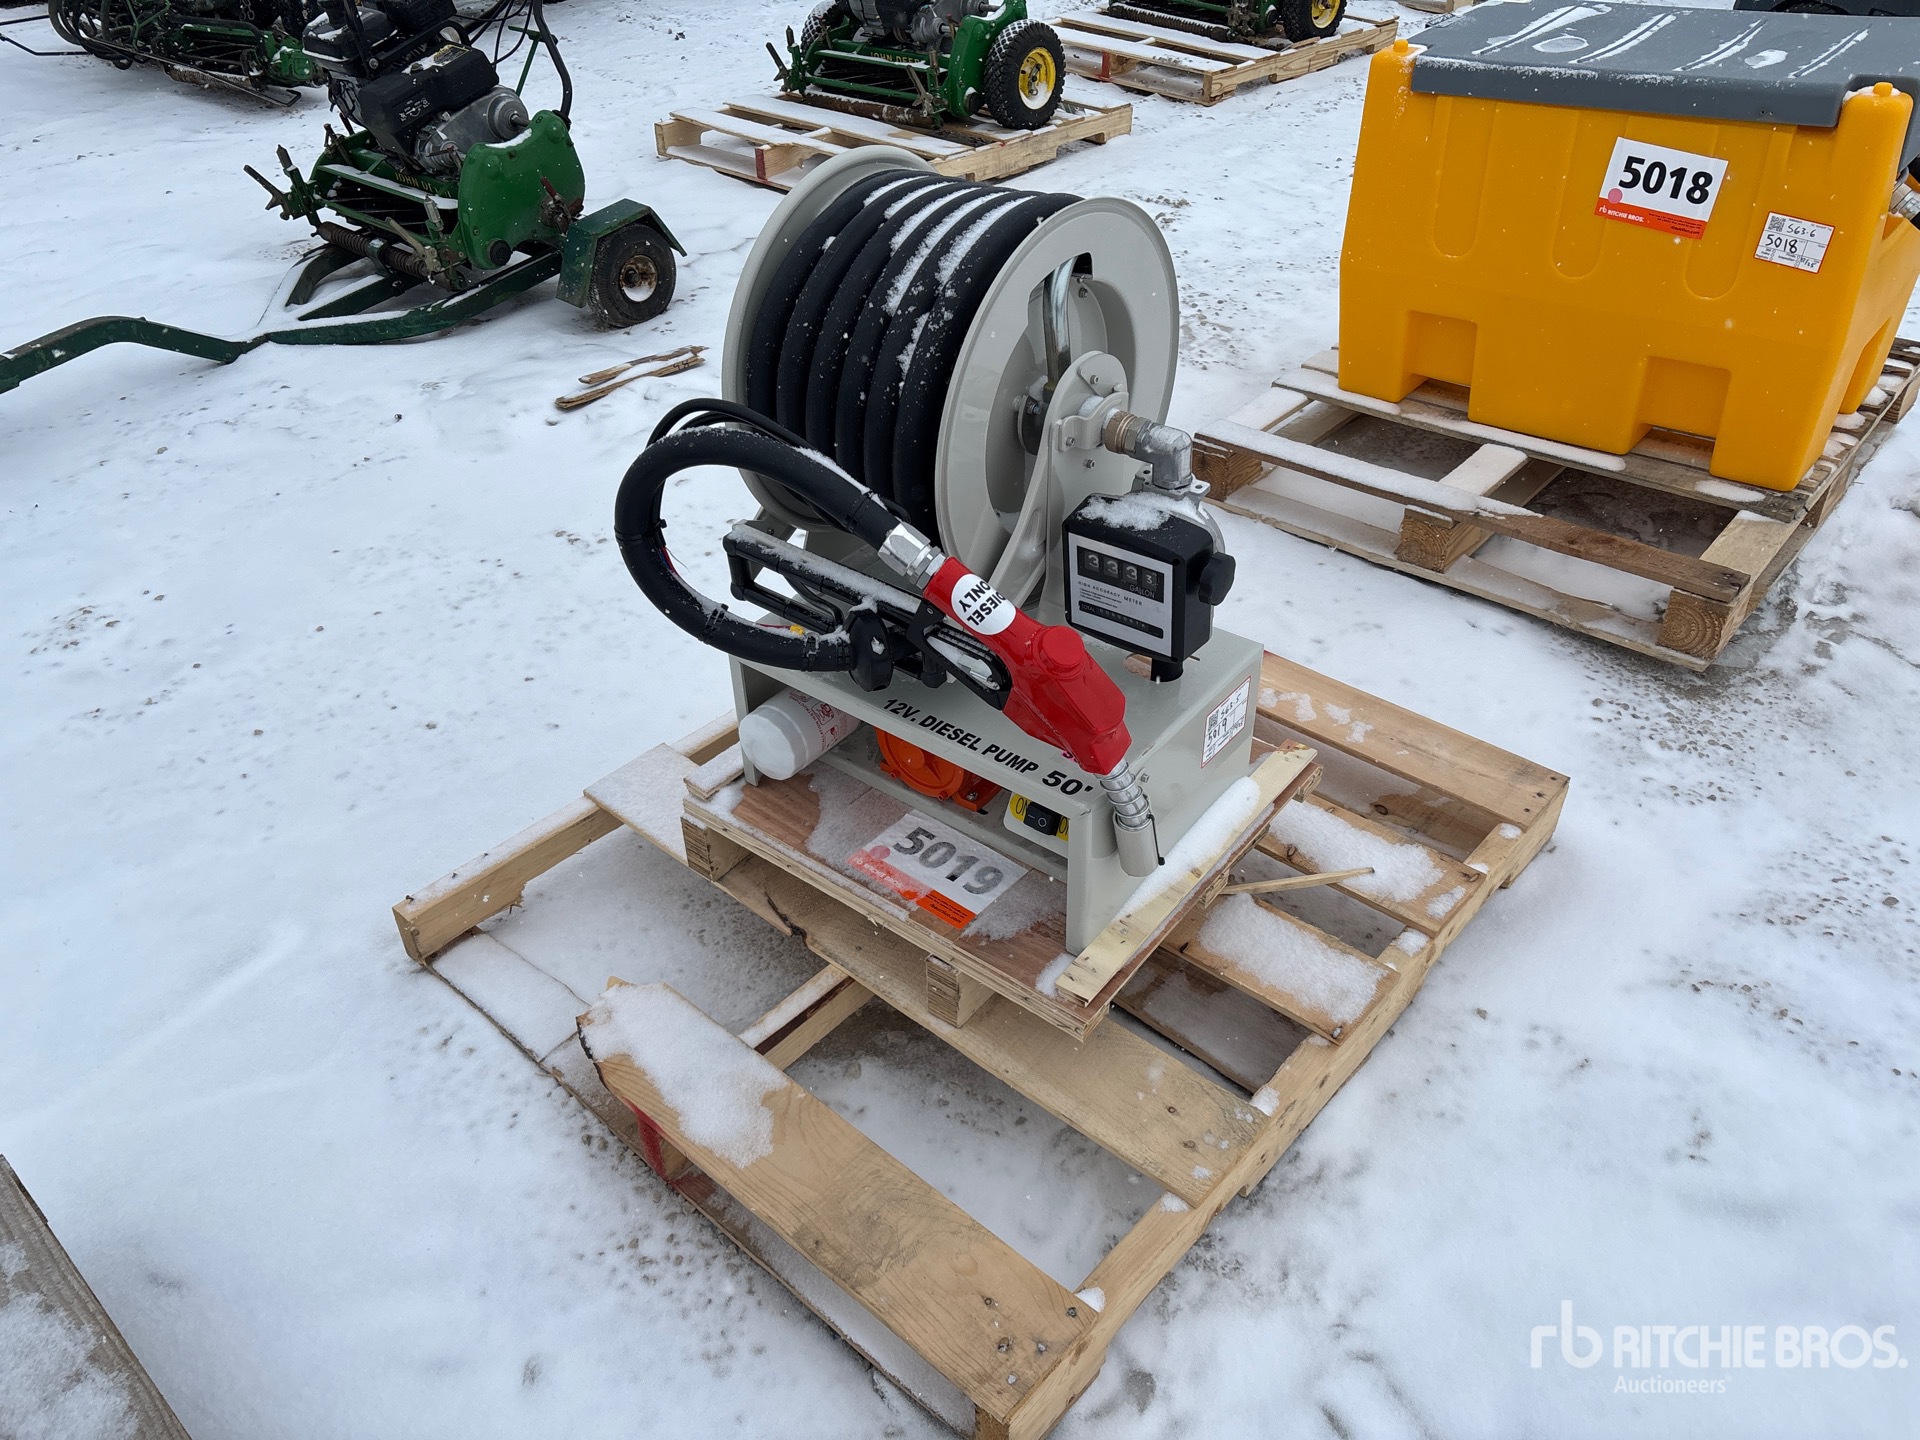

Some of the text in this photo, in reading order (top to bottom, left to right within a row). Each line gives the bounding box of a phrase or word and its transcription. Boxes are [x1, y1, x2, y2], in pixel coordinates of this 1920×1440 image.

[1618, 155, 1713, 205] 5018
[1765, 233, 1798, 254] 5018
[958, 580, 991, 614] ONLY
[1092, 585, 1120, 598] ACCURACY
[1123, 596, 1143, 606] METER
[1129, 584, 1155, 599] GALLON
[919, 715, 982, 752] DIESEL
[981, 743, 1039, 775] PUMP
[1206, 717, 1228, 748] 5019
[892, 826, 1004, 895] 5019
